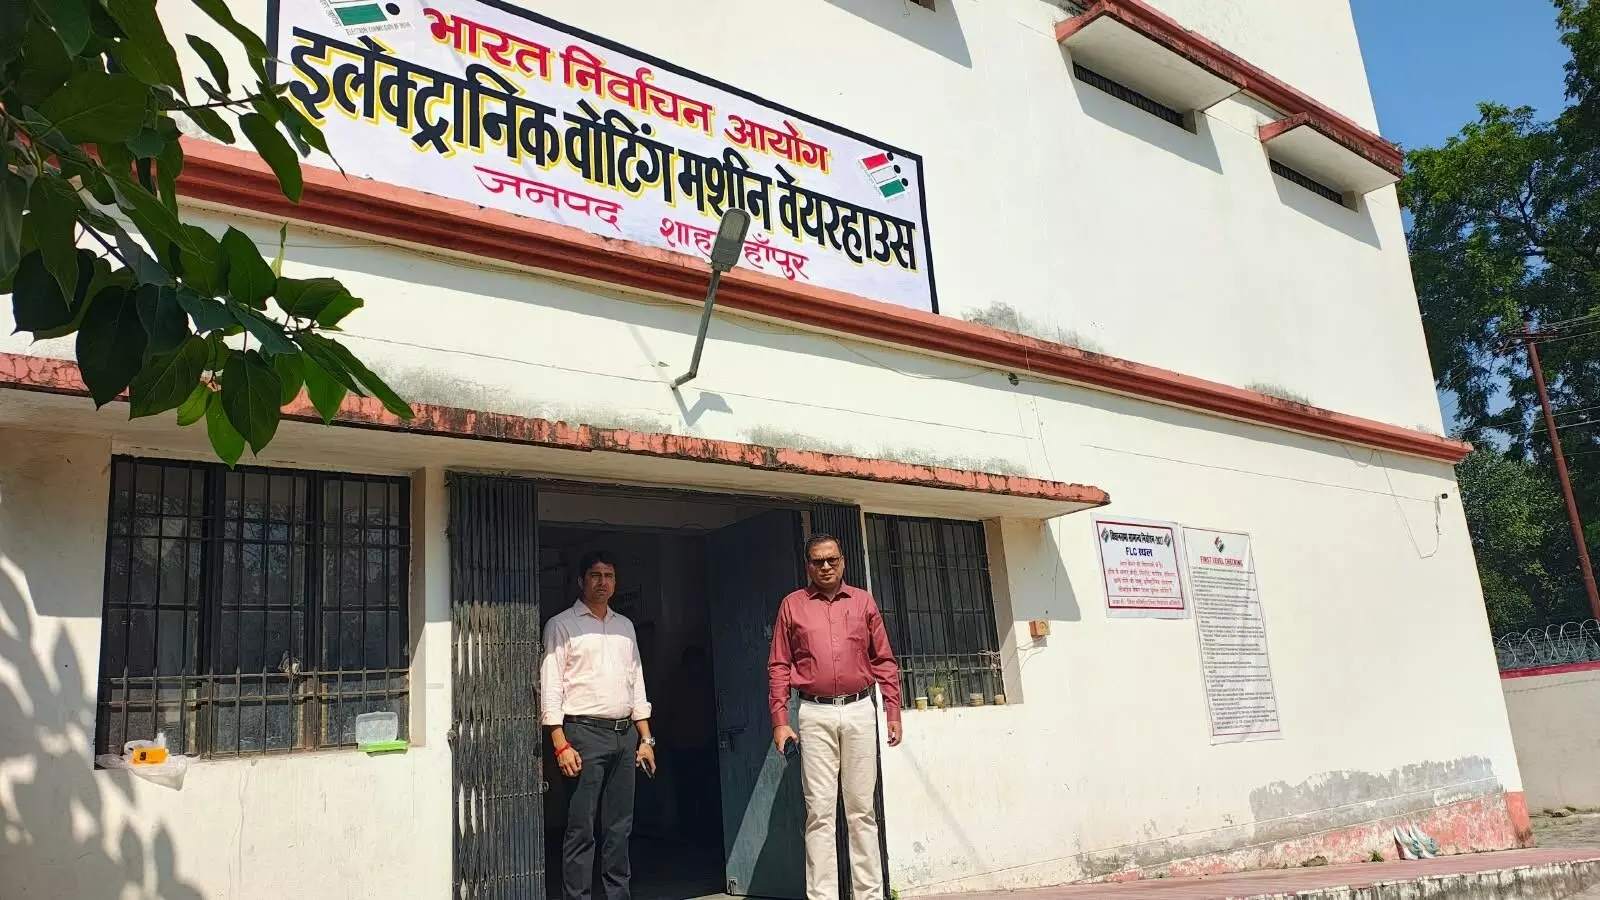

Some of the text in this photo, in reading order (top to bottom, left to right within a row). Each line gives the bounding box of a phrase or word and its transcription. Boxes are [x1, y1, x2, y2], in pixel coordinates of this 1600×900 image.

[289, 26, 917, 271] इलेक्ट्रानिक वोटिंग मशीन वेयरहाउस
[423, 7, 828, 172] भारत निर्वाचन आयोग
[473, 165, 809, 281] जनपद शाहहाँपुर
[1125, 547, 1138, 556] FLC
